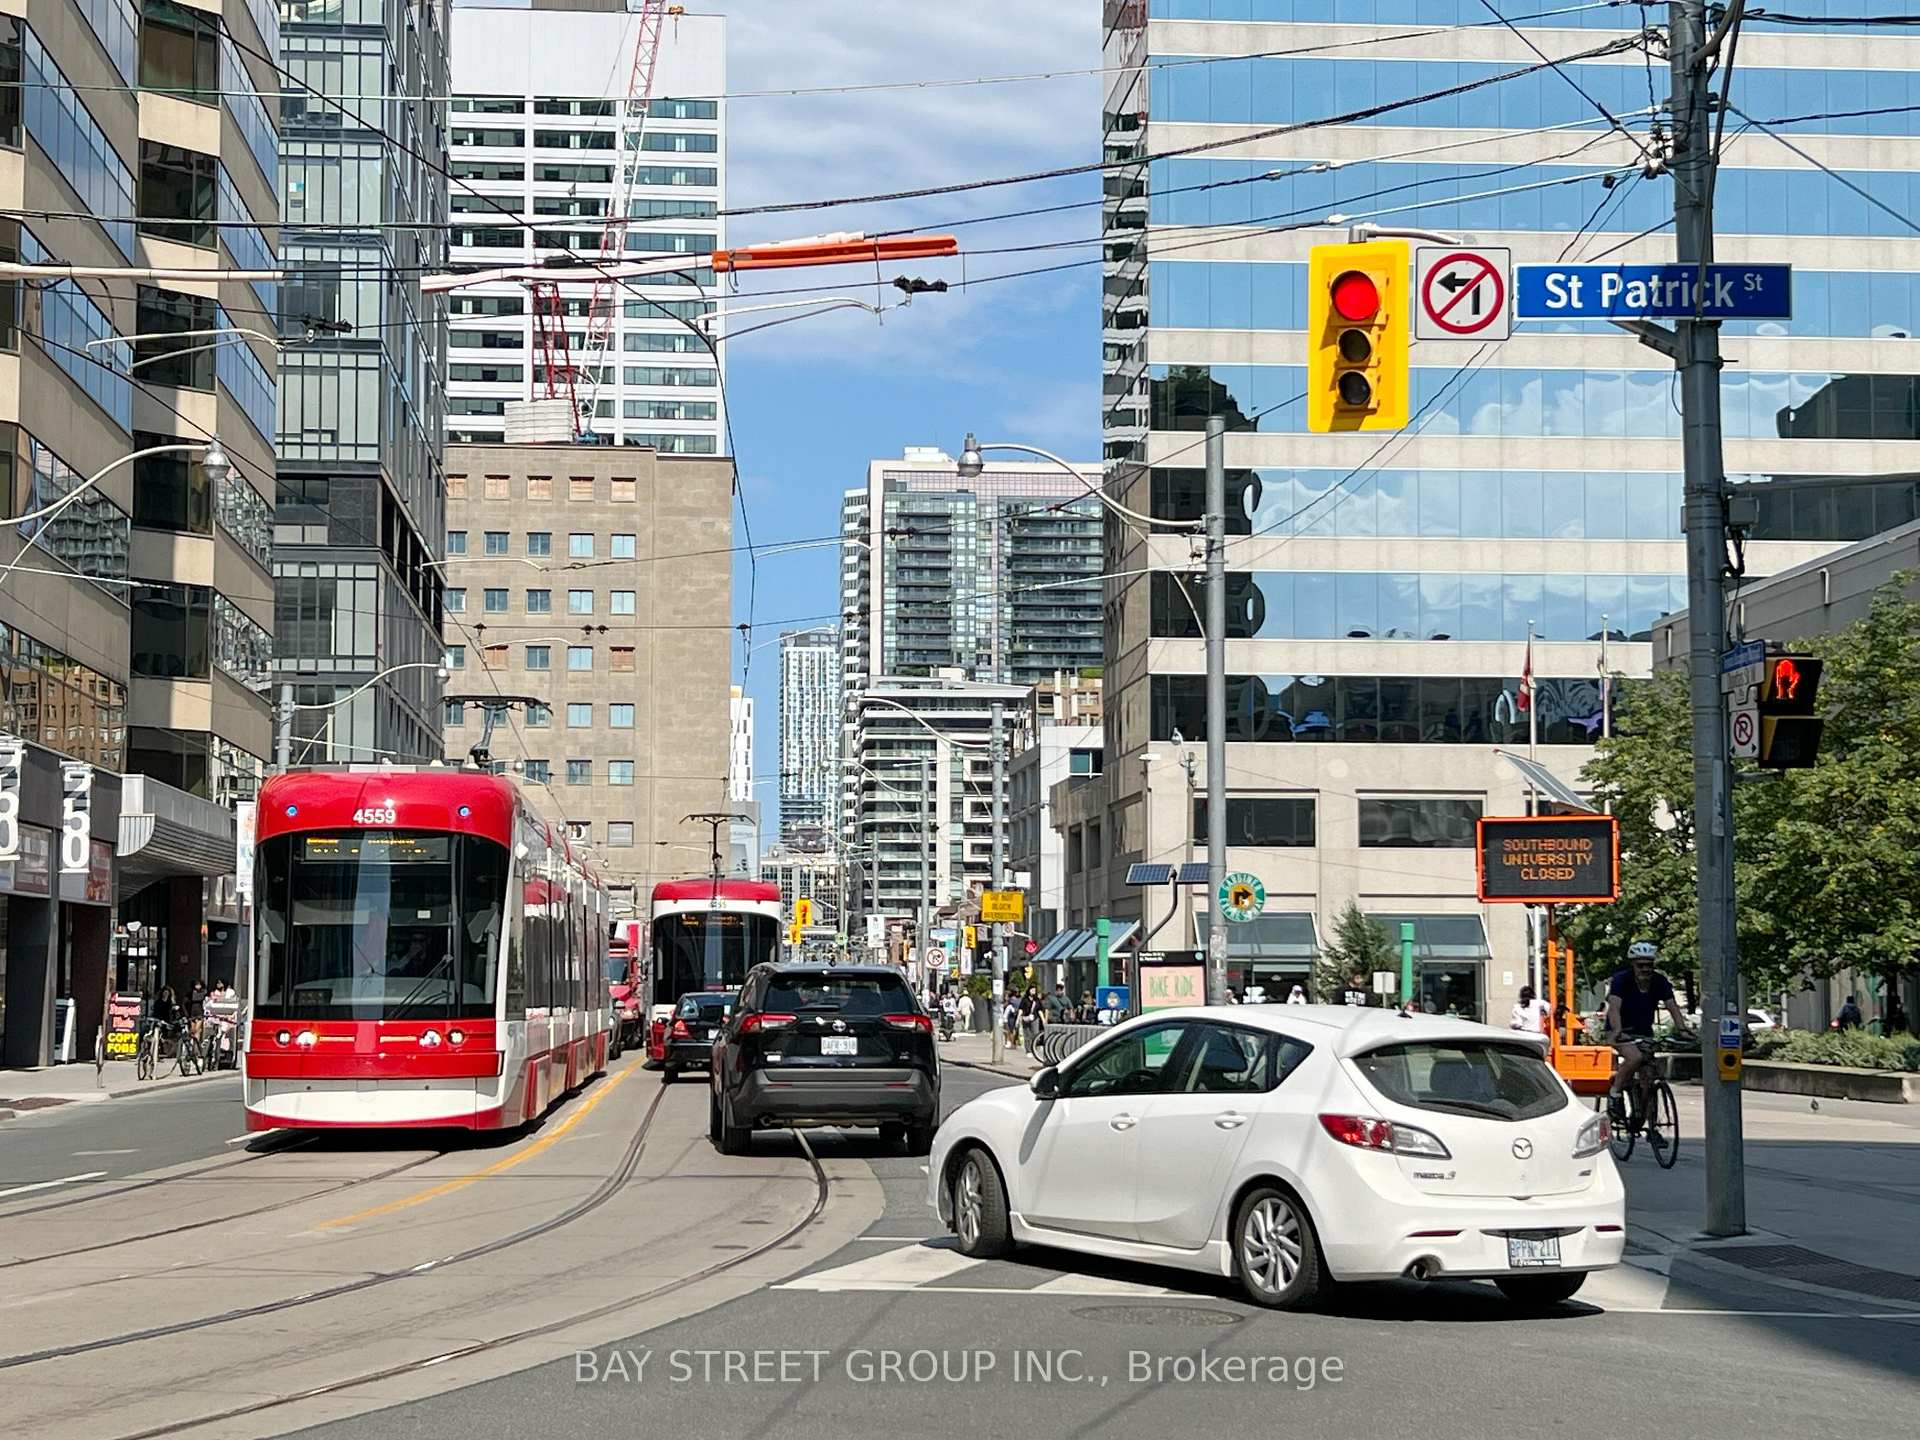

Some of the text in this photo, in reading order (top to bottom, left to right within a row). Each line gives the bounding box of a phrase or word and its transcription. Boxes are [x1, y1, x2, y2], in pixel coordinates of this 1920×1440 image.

[1545, 271, 1763, 309] St Patrick St
[62, 770, 92, 869] 250
[353, 808, 397, 824] 4559
[1503, 838, 1592, 851] SOUTHBOUND
[1503, 853, 1593, 866] UNIVERSITY
[1520, 868, 1575, 880] CLOSED
[1149, 975, 1196, 998] BIKE RIDE
[107, 1032, 139, 1043] COPY
[107, 1043, 137, 1054] FOBS
